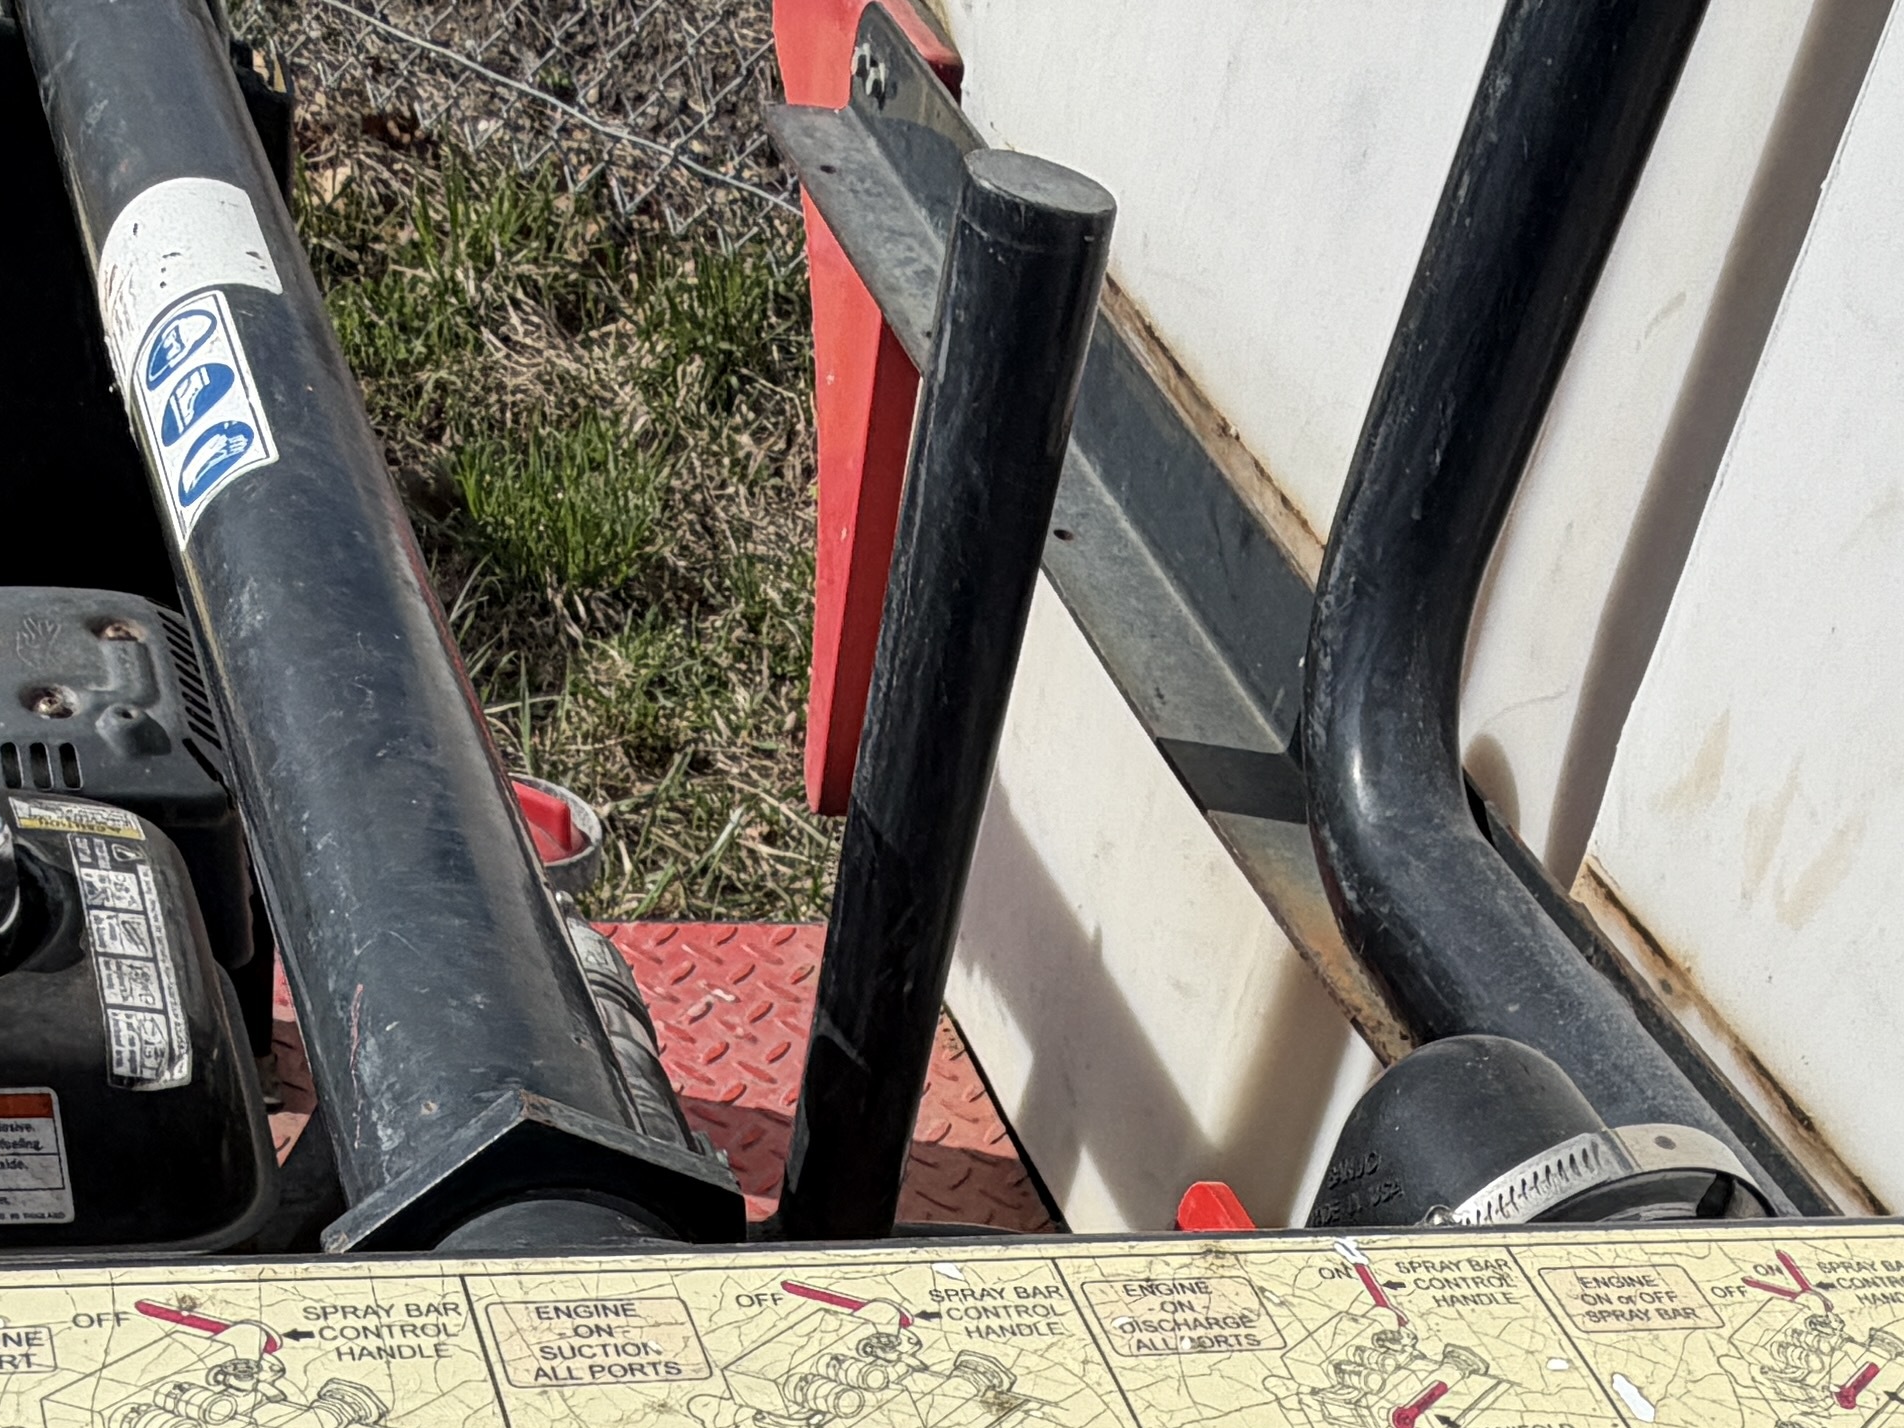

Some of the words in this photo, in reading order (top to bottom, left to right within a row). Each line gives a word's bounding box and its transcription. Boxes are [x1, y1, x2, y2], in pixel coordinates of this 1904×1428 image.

[1319, 1264, 1355, 1281] ON
[1396, 1259, 1464, 1276] SPRAY
[1468, 1258, 1512, 1273] BAR
[1753, 1263, 1784, 1277] ON
[1816, 1260, 1877, 1275] SPRAY
[1123, 1280, 1212, 1298] ENGINE
[1414, 1273, 1516, 1292] CONTROL
[1580, 1275, 1660, 1289] ENGINE
[735, 1292, 785, 1308] OFF
[929, 1286, 1006, 1303] SPRAY
[1013, 1285, 1064, 1300] BAR
[1434, 1290, 1521, 1308] HANDLE
[1581, 1293, 1613, 1306] ON
[1639, 1291, 1678, 1304] OFF
[1710, 1285, 1747, 1299] OFF
[302, 1302, 395, 1324] SPRAY
[404, 1300, 462, 1320] BAR
[535, 1302, 638, 1321] ENGINE
[946, 1303, 1064, 1321] CONTROL
[1160, 1300, 1197, 1314] ON
[1585, 1308, 1651, 1323] SPRAY
[1655, 1307, 1703, 1320] BAR
[72, 1312, 130, 1329] OFF
[1119, 1315, 1258, 1335] DISCHARGE
[319, 1321, 460, 1343] CONTROL
[573, 1323, 615, 1339] ON
[964, 1321, 1064, 1339] HANDLE
[336, 1341, 453, 1362] HANDLE
[540, 1341, 664, 1361] SUCTION
[1137, 1337, 1178, 1352] ALL
[534, 1366, 584, 1382] ALL
[590, 1361, 683, 1381] PORTS
